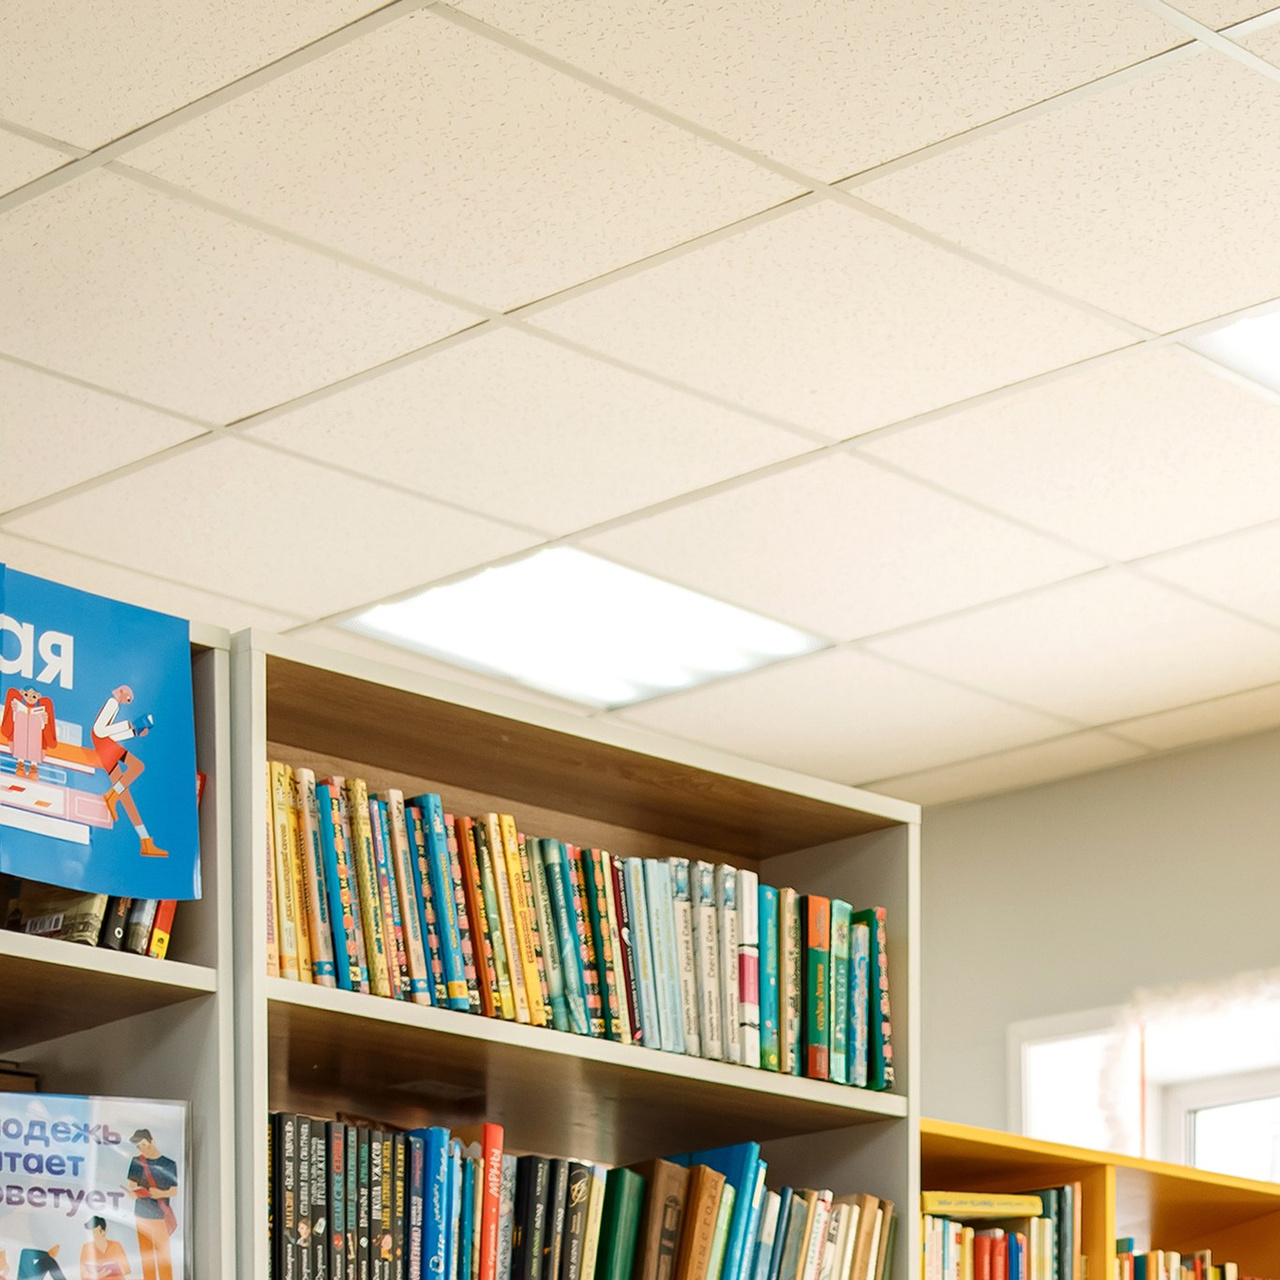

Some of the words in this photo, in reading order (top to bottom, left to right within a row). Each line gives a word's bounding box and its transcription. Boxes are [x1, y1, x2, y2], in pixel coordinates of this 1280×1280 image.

[2, 1118, 122, 1148] одежь
[372, 1141, 382, 1181] УЖАСОВ
[372, 1186, 382, 1220] ШКОЛА
[702, 1177, 720, 1228] ГОДЫ
